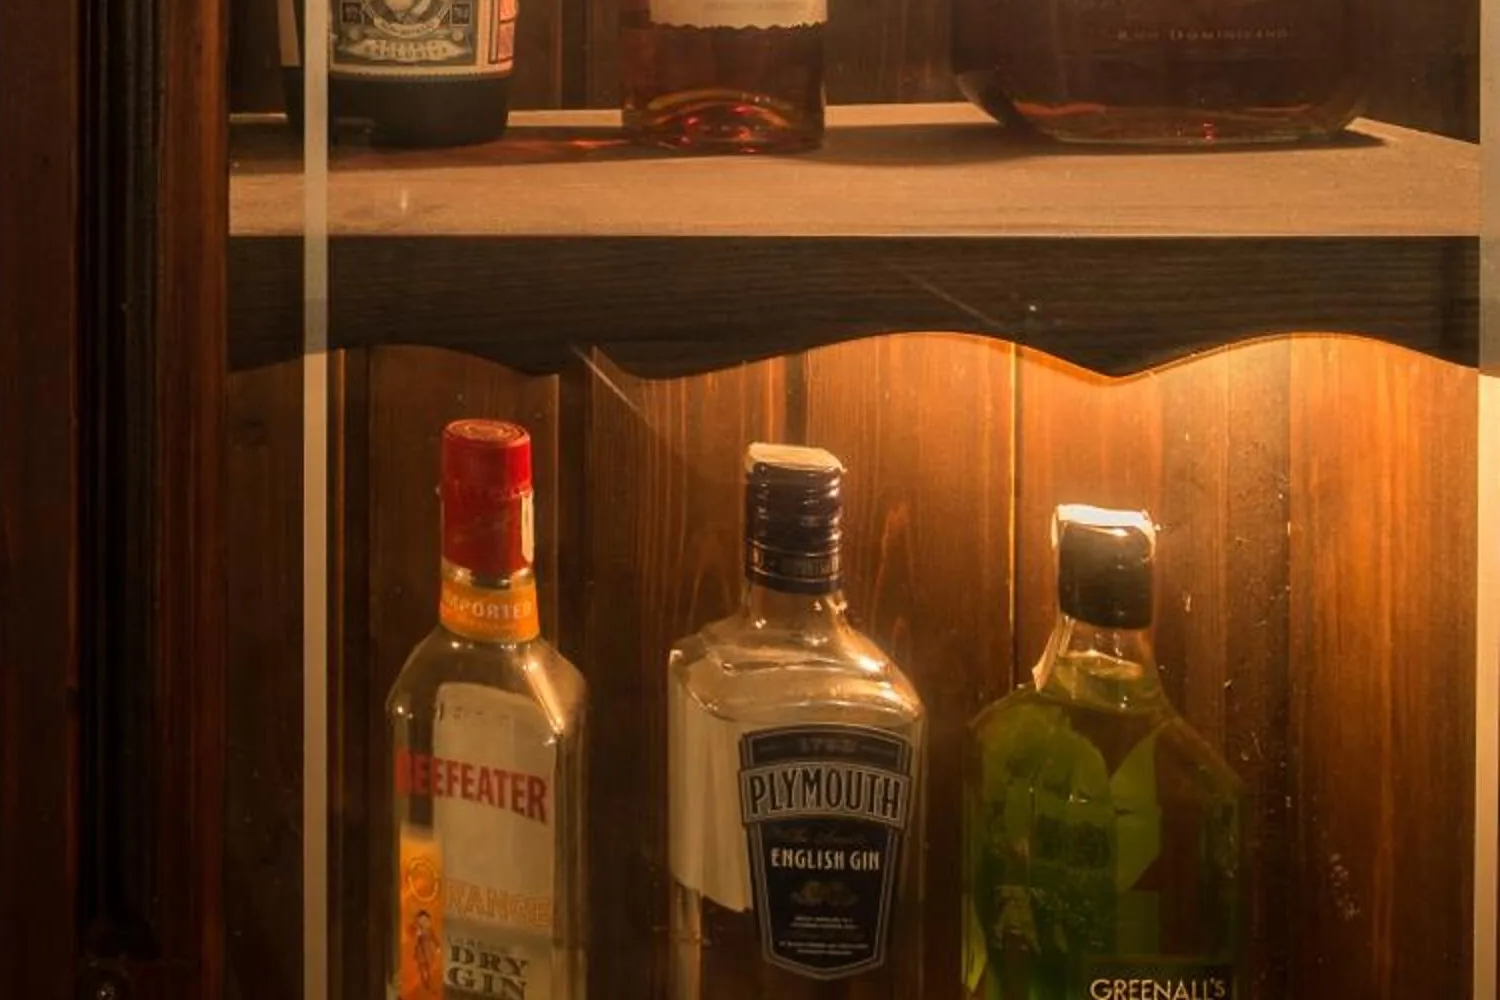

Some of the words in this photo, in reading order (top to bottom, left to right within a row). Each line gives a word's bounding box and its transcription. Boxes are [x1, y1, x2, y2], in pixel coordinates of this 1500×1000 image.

[749, 767, 901, 820] PLYMOUTH
[770, 847, 846, 871] ENGLISH
[850, 850, 880, 872] GIN
[450, 944, 530, 977] DRY
[1089, 976, 1227, 1000] GREENALL'S
